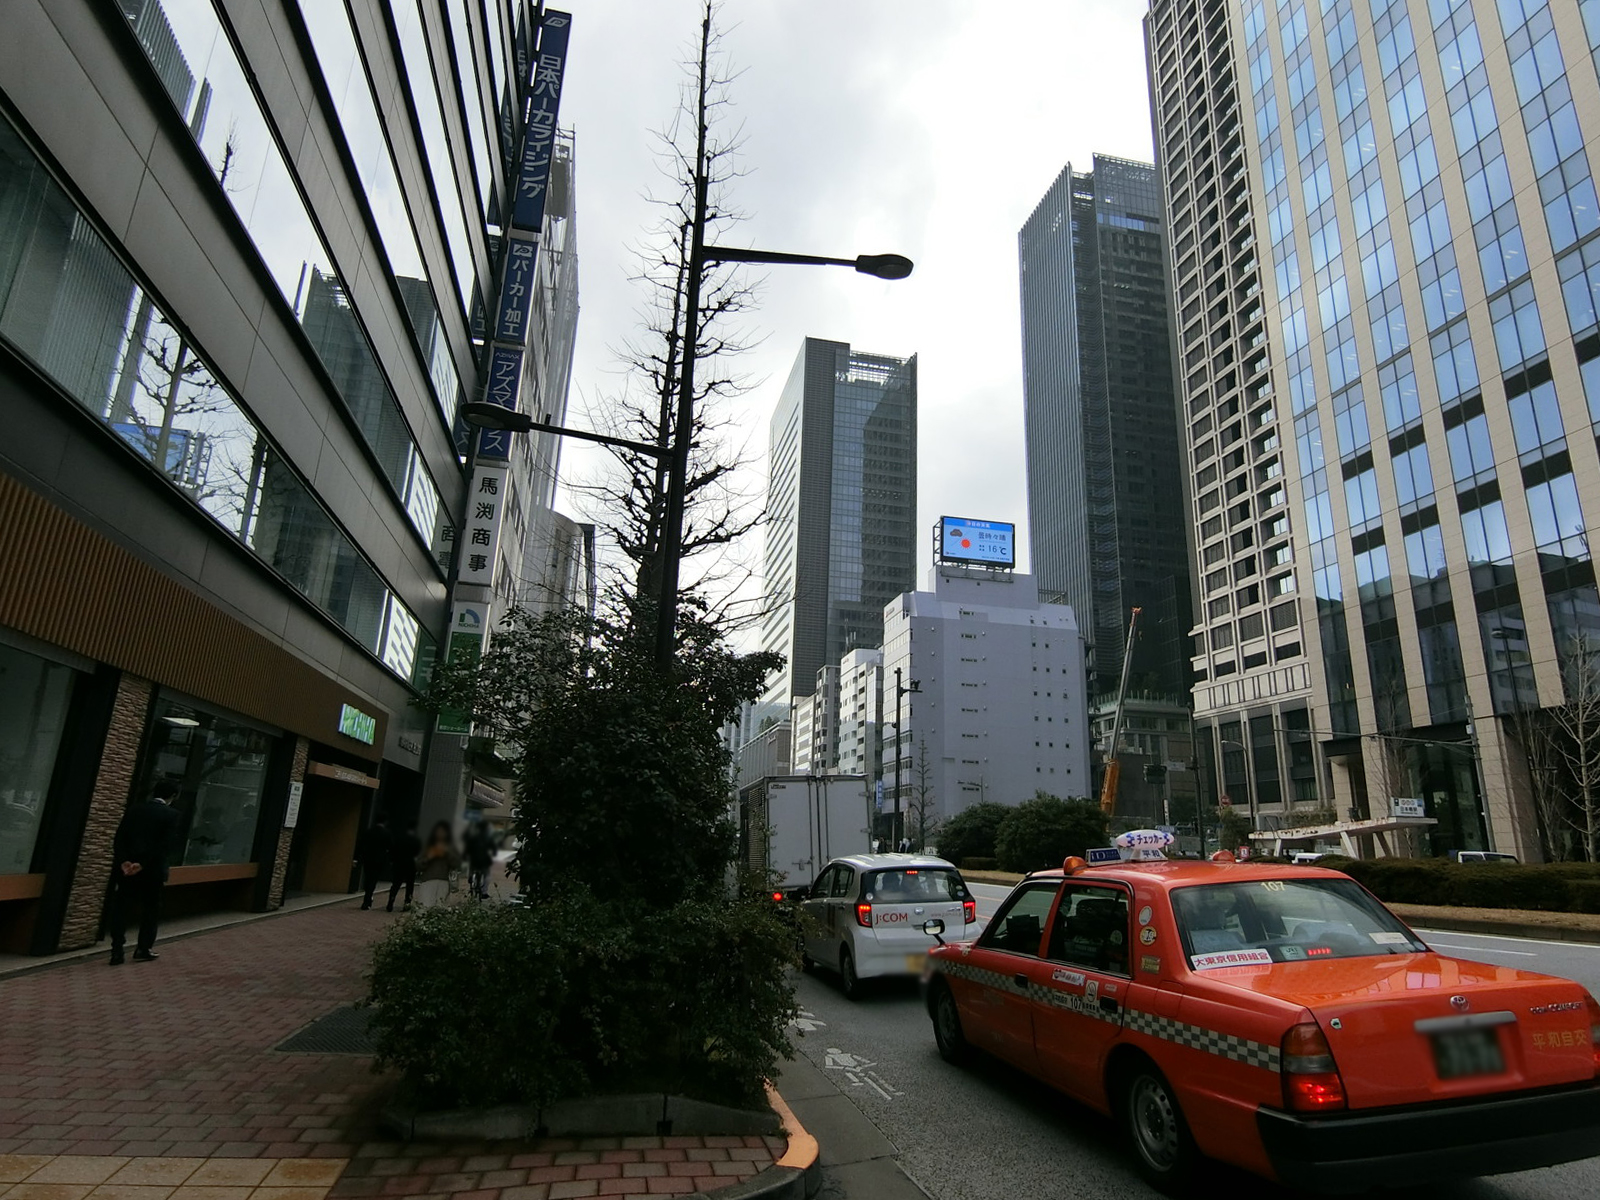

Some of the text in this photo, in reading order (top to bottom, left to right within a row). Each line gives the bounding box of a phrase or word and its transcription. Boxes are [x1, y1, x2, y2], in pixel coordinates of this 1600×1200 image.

[522, 54, 562, 199] 日本パーカライジング
[502, 259, 529, 337] パーカー加工
[485, 361, 516, 452] アズマス
[1137, 833, 1163, 845] チェッカー
[1261, 881, 1285, 892] 107
[875, 912, 909, 925] J:COM
[1194, 952, 1269, 968] 大東京信用組合
[1070, 996, 1083, 1010] 107
